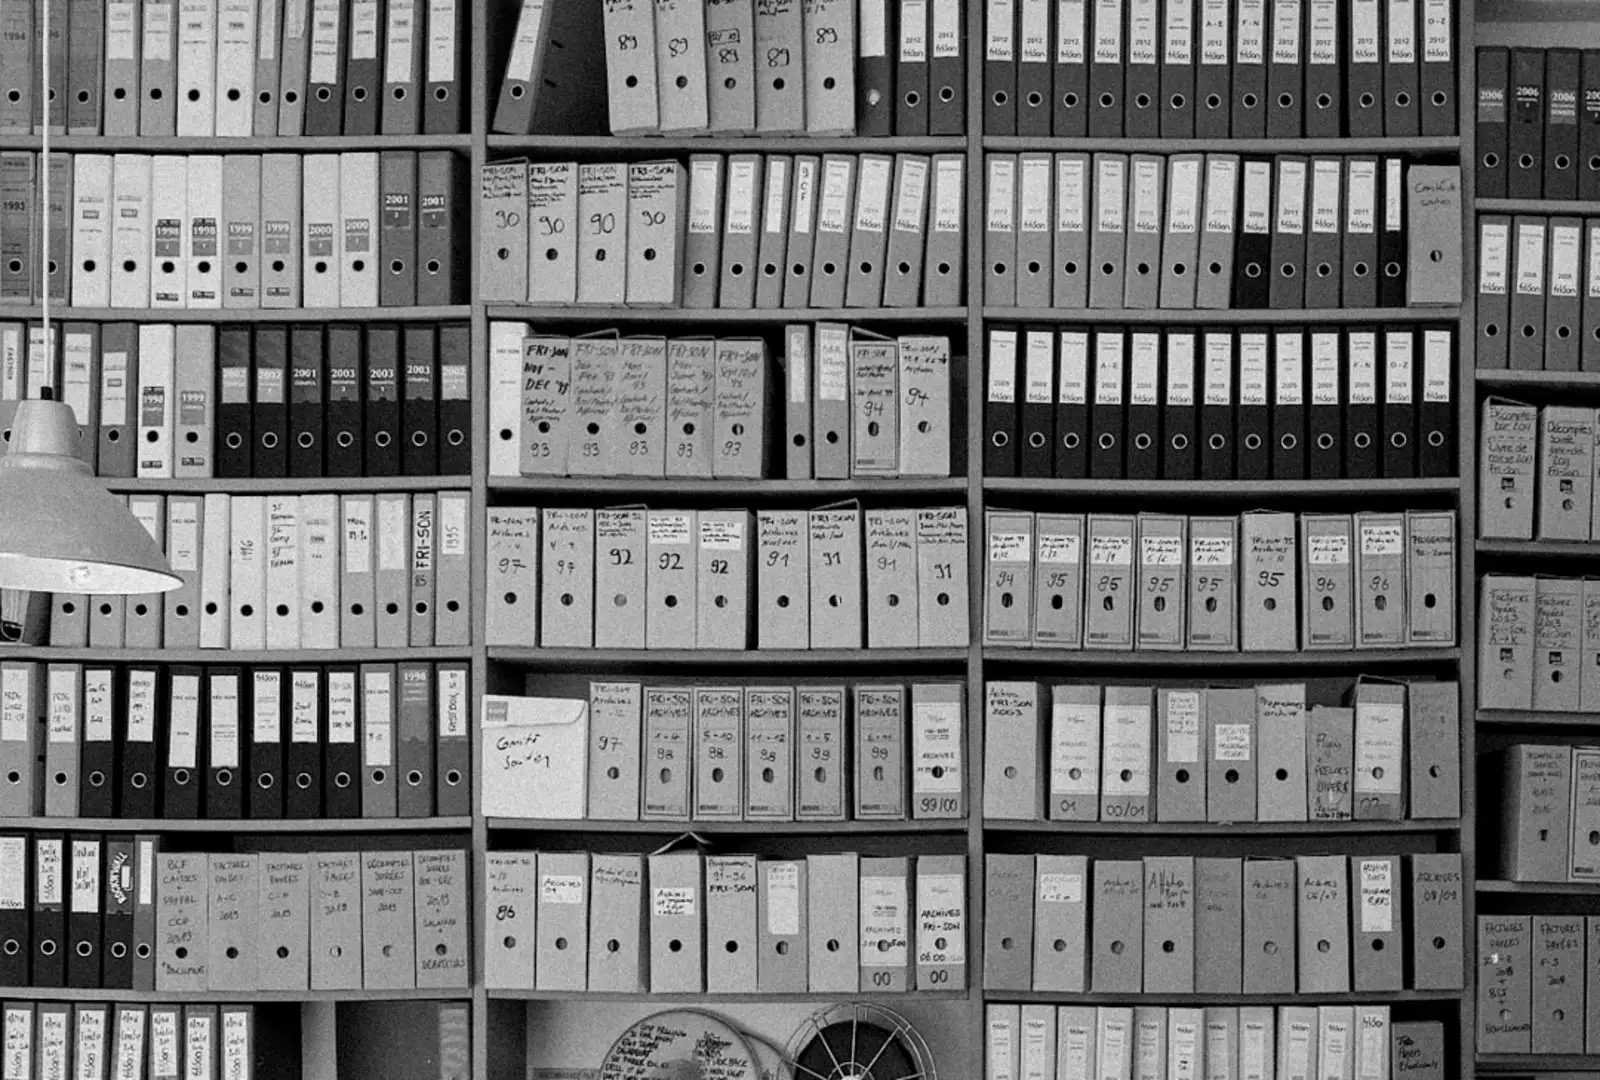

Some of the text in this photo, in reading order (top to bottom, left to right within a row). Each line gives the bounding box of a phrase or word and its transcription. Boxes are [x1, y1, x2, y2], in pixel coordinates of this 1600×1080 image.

[618, 34, 637, 50] 89
[816, 27, 838, 44] 89
[668, 37, 688, 57] 89
[718, 48, 739, 64] 89
[767, 47, 791, 67] 89
[1480, 89, 1503, 101] 2006
[1516, 86, 1539, 97] 2006
[1551, 91, 1575, 102] 2006
[386, 194, 409, 205] 2001
[422, 196, 445, 207] 2001
[346, 220, 369, 231] 2000
[495, 209, 520, 229] 90
[539, 215, 565, 236] 90
[590, 211, 615, 235] 90
[641, 210, 666, 227] 90
[156, 226, 179, 237] 1998
[193, 225, 216, 236] 1998
[309, 225, 332, 236] 2000
[293, 368, 316, 378] 2001
[331, 368, 355, 379] 2003
[370, 369, 394, 379] 2003
[407, 364, 430, 375] 2003
[905, 387, 930, 407] 94
[863, 401, 884, 417] 94
[530, 443, 550, 457] 93
[582, 442, 600, 457] 93
[628, 441, 649, 456] 93
[676, 442, 693, 458] 93
[722, 441, 741, 457] 93
[416, 510, 431, 569] FRI-SON
[609, 548, 635, 566] 92
[658, 552, 685, 571] 92
[766, 550, 790, 567] 91
[822, 551, 841, 567] 91
[877, 556, 897, 572] 91
[498, 557, 528, 575] 97
[710, 558, 730, 575] 92
[934, 563, 952, 580] 91
[996, 571, 1015, 588] 94
[1046, 572, 1069, 588] 95
[1097, 576, 1123, 592] 95
[1147, 577, 1174, 593] 95
[1197, 577, 1224, 593] 95
[1258, 571, 1285, 587] 95
[1316, 576, 1336, 592] 96
[1369, 575, 1389, 591] 96
[597, 734, 624, 752] 97
[656, 748, 674, 760] 98
[708, 747, 725, 759] 98
[760, 748, 777, 762] 98
[811, 747, 830, 761] 99
[870, 747, 889, 760] 99
[1106, 799, 1145, 817] 00/01
[873, 970, 892, 987] 00
[929, 969, 949, 984] 00
